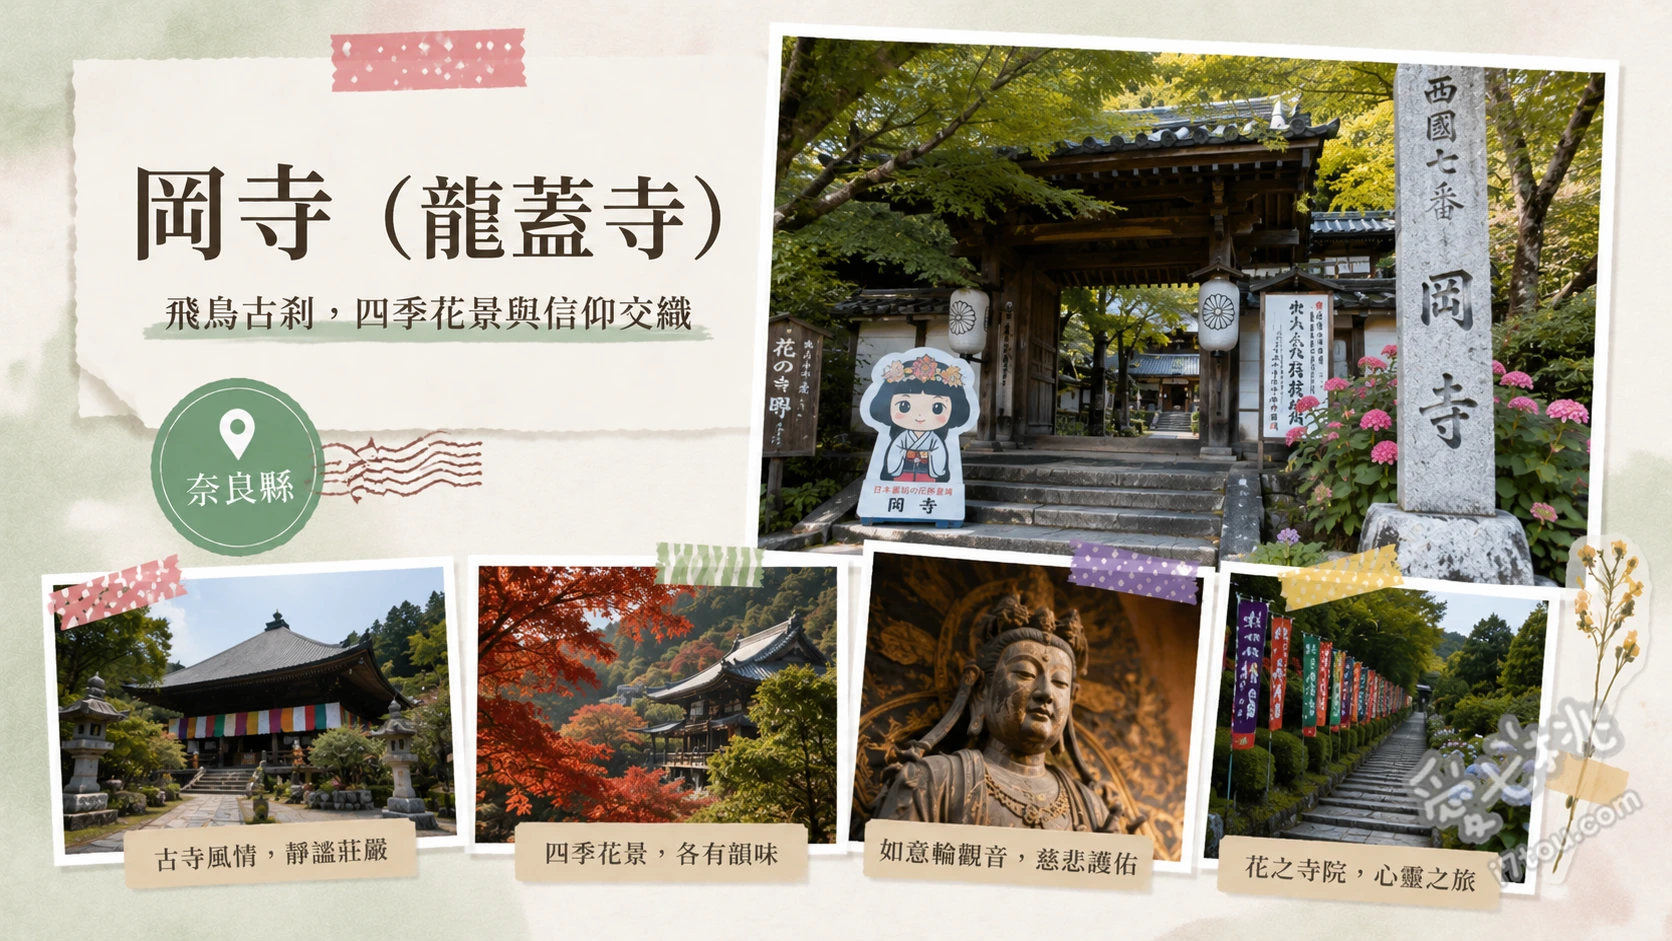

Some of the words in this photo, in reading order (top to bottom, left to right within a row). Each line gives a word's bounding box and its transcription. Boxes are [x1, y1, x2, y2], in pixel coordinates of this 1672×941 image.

[1424, 74, 1465, 221] 西國七番
[1419, 268, 1478, 450] 岡寺
